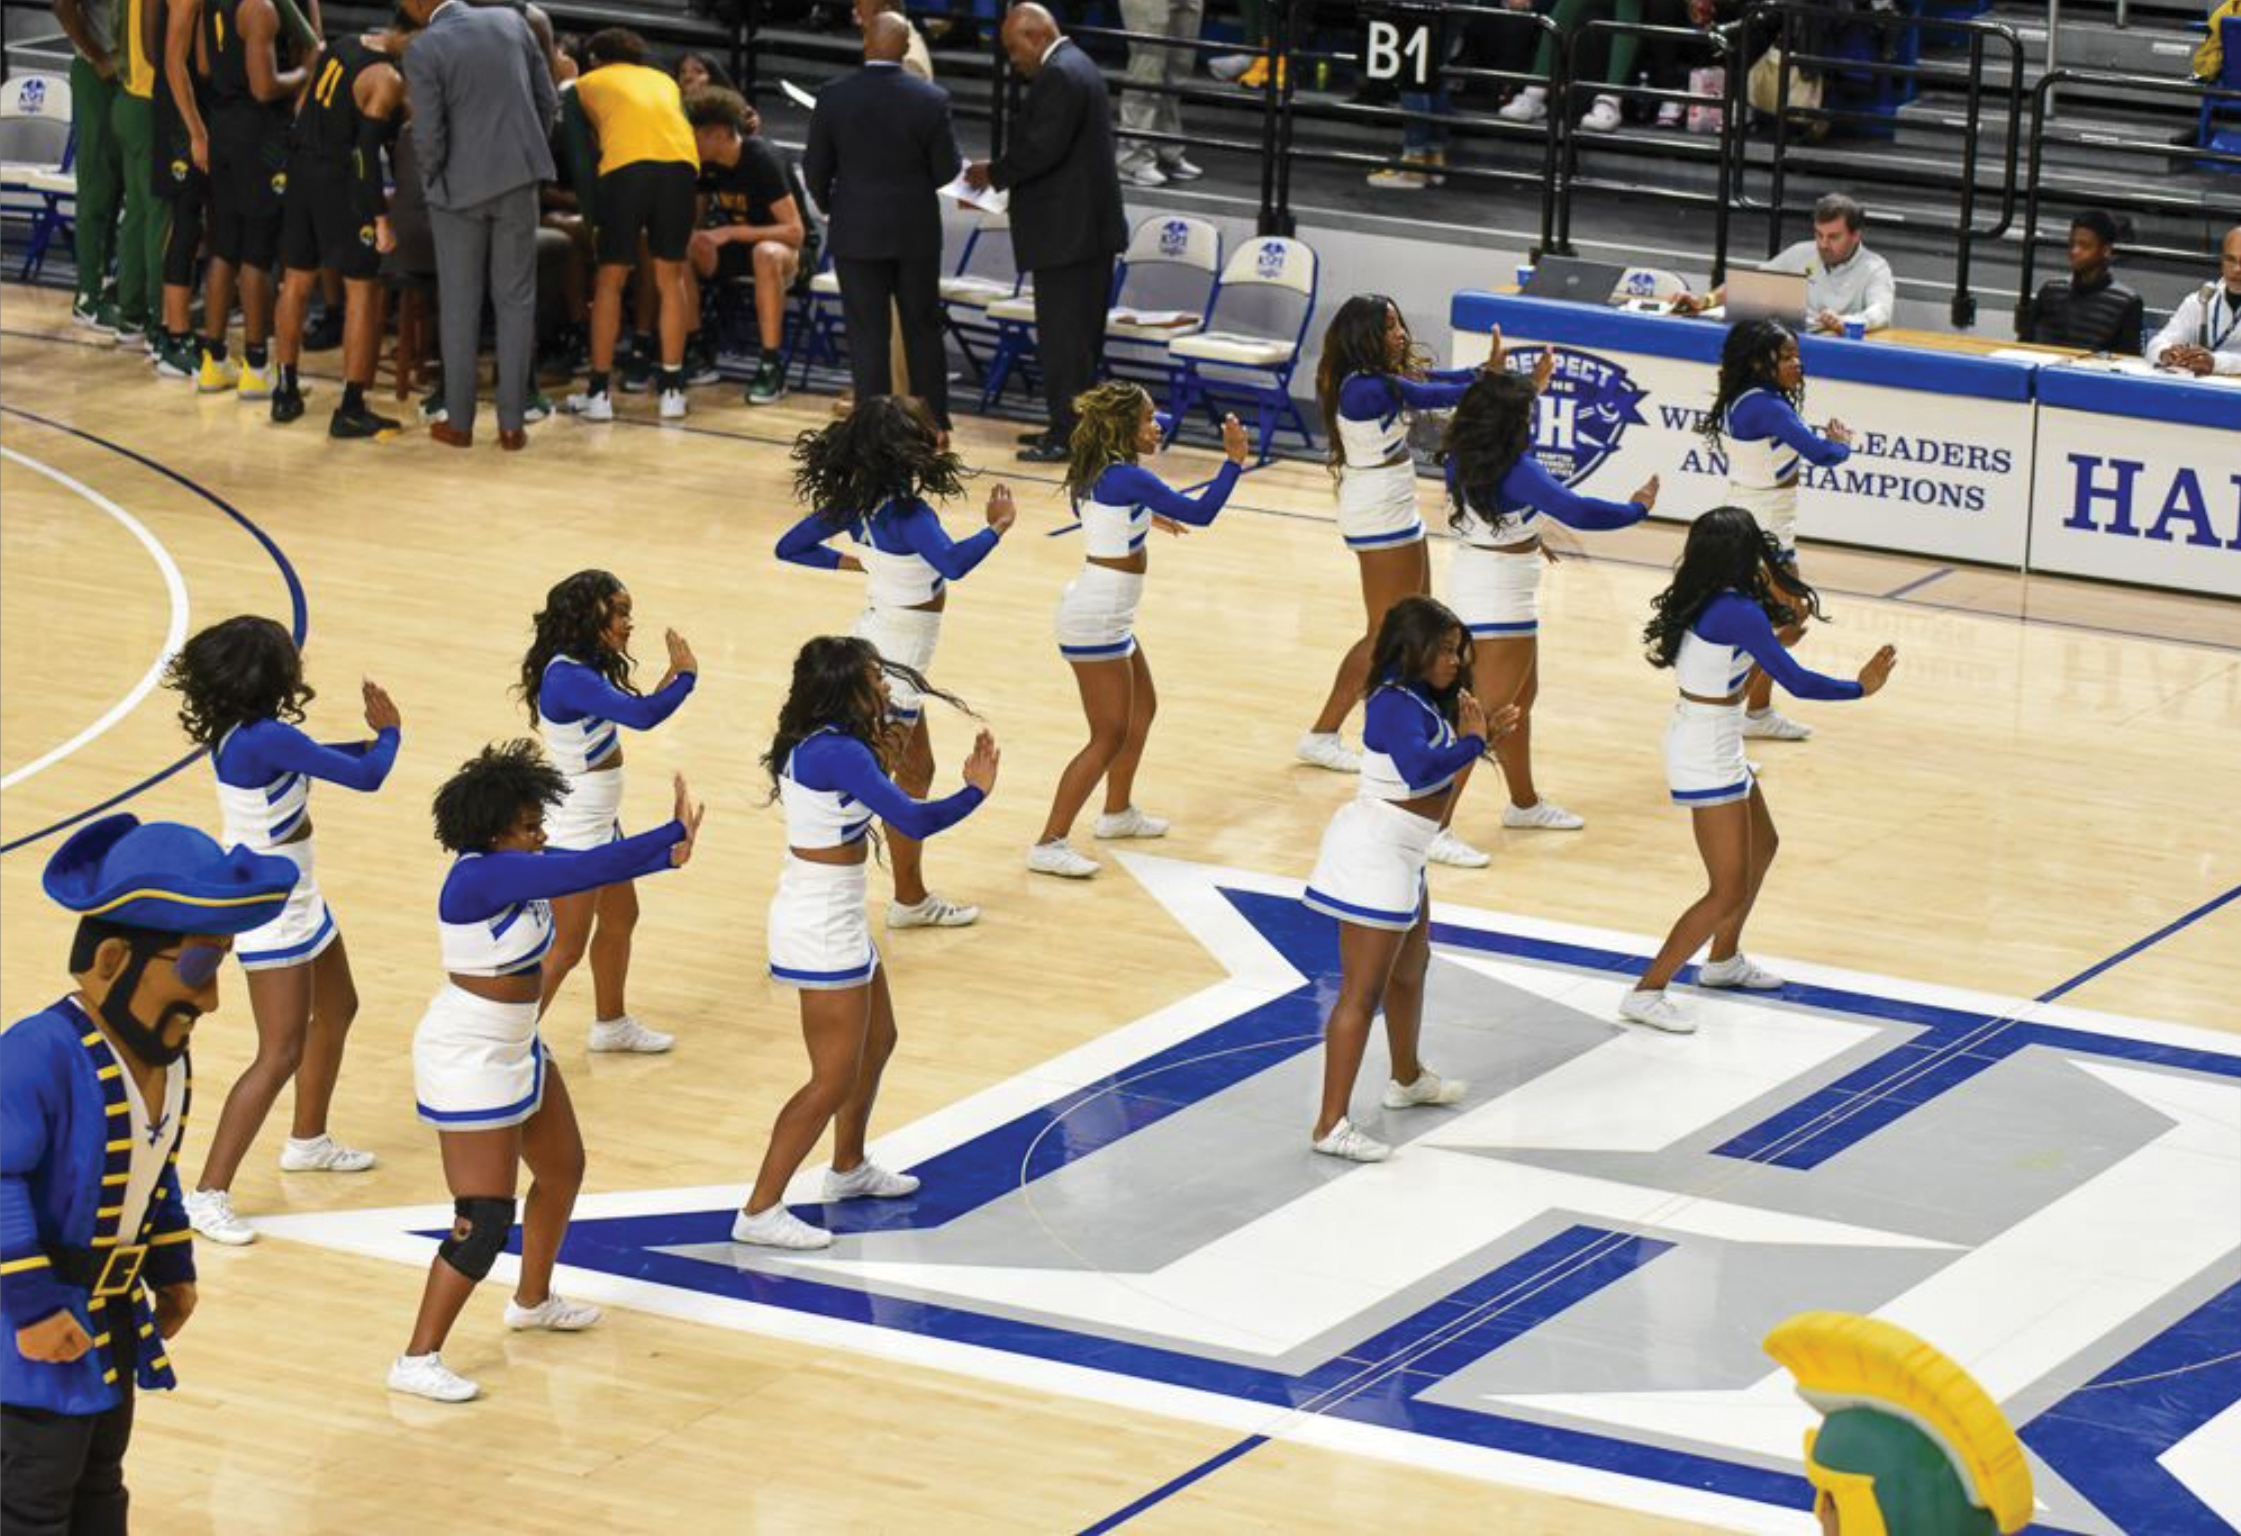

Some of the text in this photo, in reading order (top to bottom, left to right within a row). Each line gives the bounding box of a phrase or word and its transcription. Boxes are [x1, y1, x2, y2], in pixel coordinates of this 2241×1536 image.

[1367, 21, 1429, 83] B1
[1505, 352, 1614, 388] REPECT
[1535, 395, 1579, 449] H
[1679, 449, 1986, 511] AN HAMPIONS
[2063, 452, 2241, 552] HA
